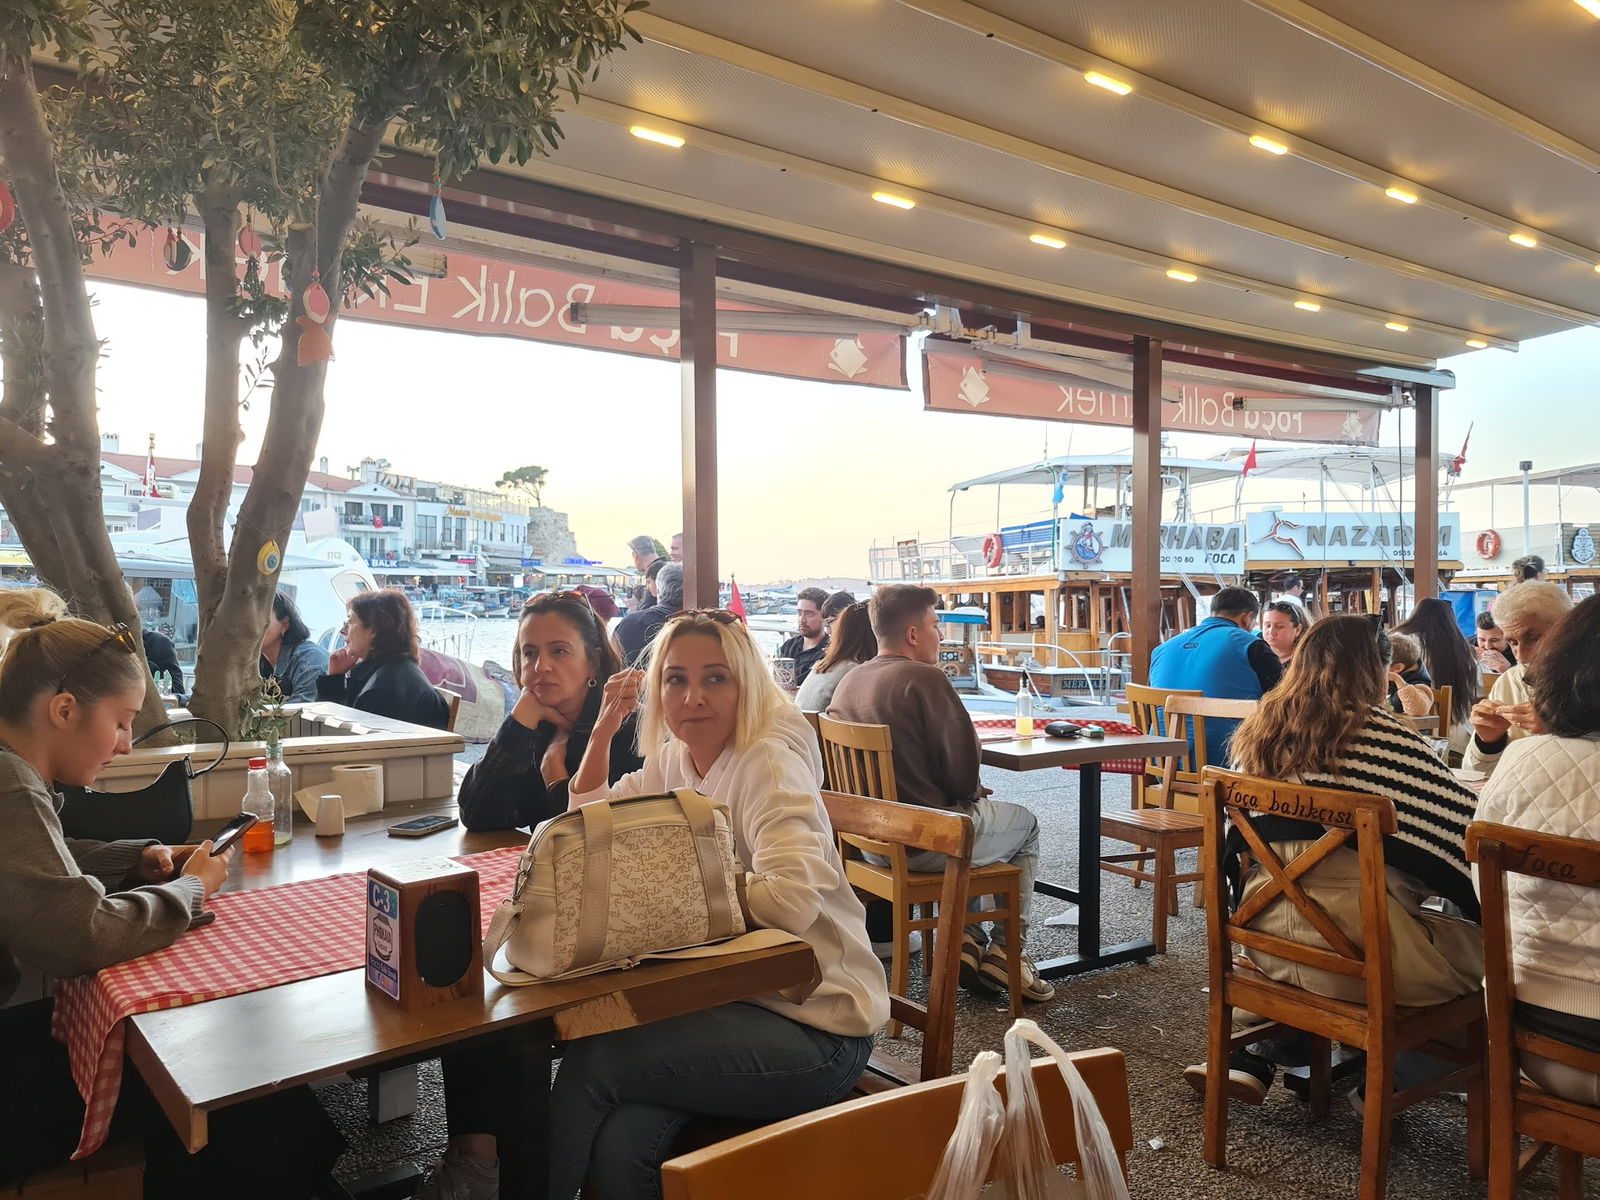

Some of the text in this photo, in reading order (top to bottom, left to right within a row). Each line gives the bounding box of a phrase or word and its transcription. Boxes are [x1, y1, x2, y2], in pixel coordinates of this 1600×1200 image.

[1110, 523, 1240, 550] MHABA
[1306, 525, 1452, 547] NAZARM
[372, 884, 390, 913] C-3
